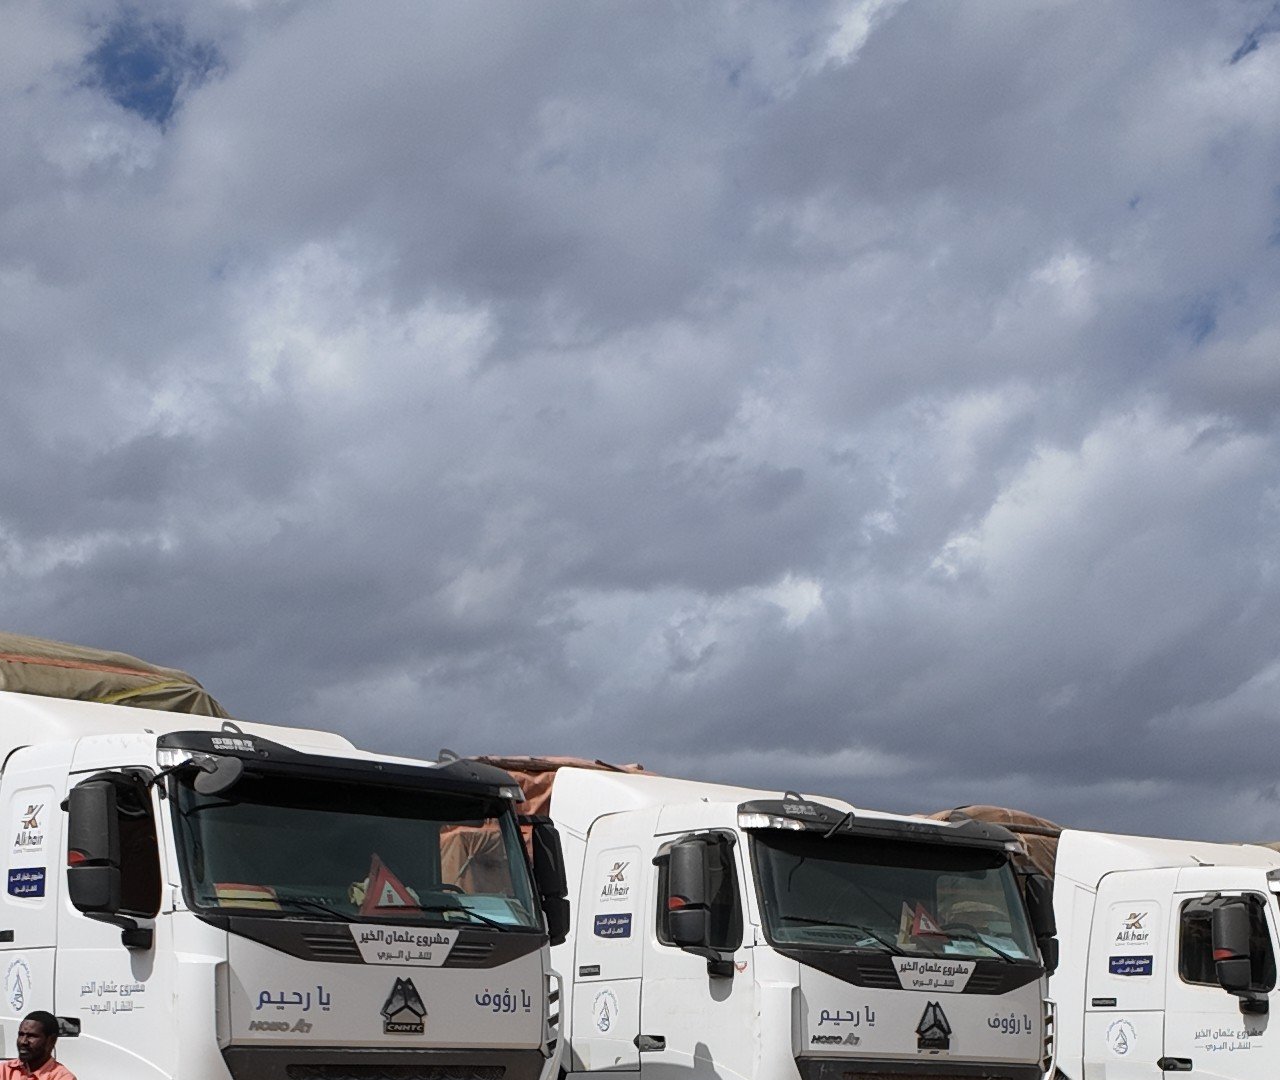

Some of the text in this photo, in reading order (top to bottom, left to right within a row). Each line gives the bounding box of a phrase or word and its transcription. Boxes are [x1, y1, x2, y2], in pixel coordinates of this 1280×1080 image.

[359, 930, 384, 944] الخير
[416, 933, 449, 946] مشروع
[256, 986, 330, 1011] يا رحيم
[476, 988, 530, 1012] يا رؤوف
[818, 1006, 874, 1027] يا رحيم
[988, 1013, 1032, 1034] يا رؤوف
[1195, 1029, 1211, 1040] الخير
[1213, 1029, 1234, 1039] عثمان
